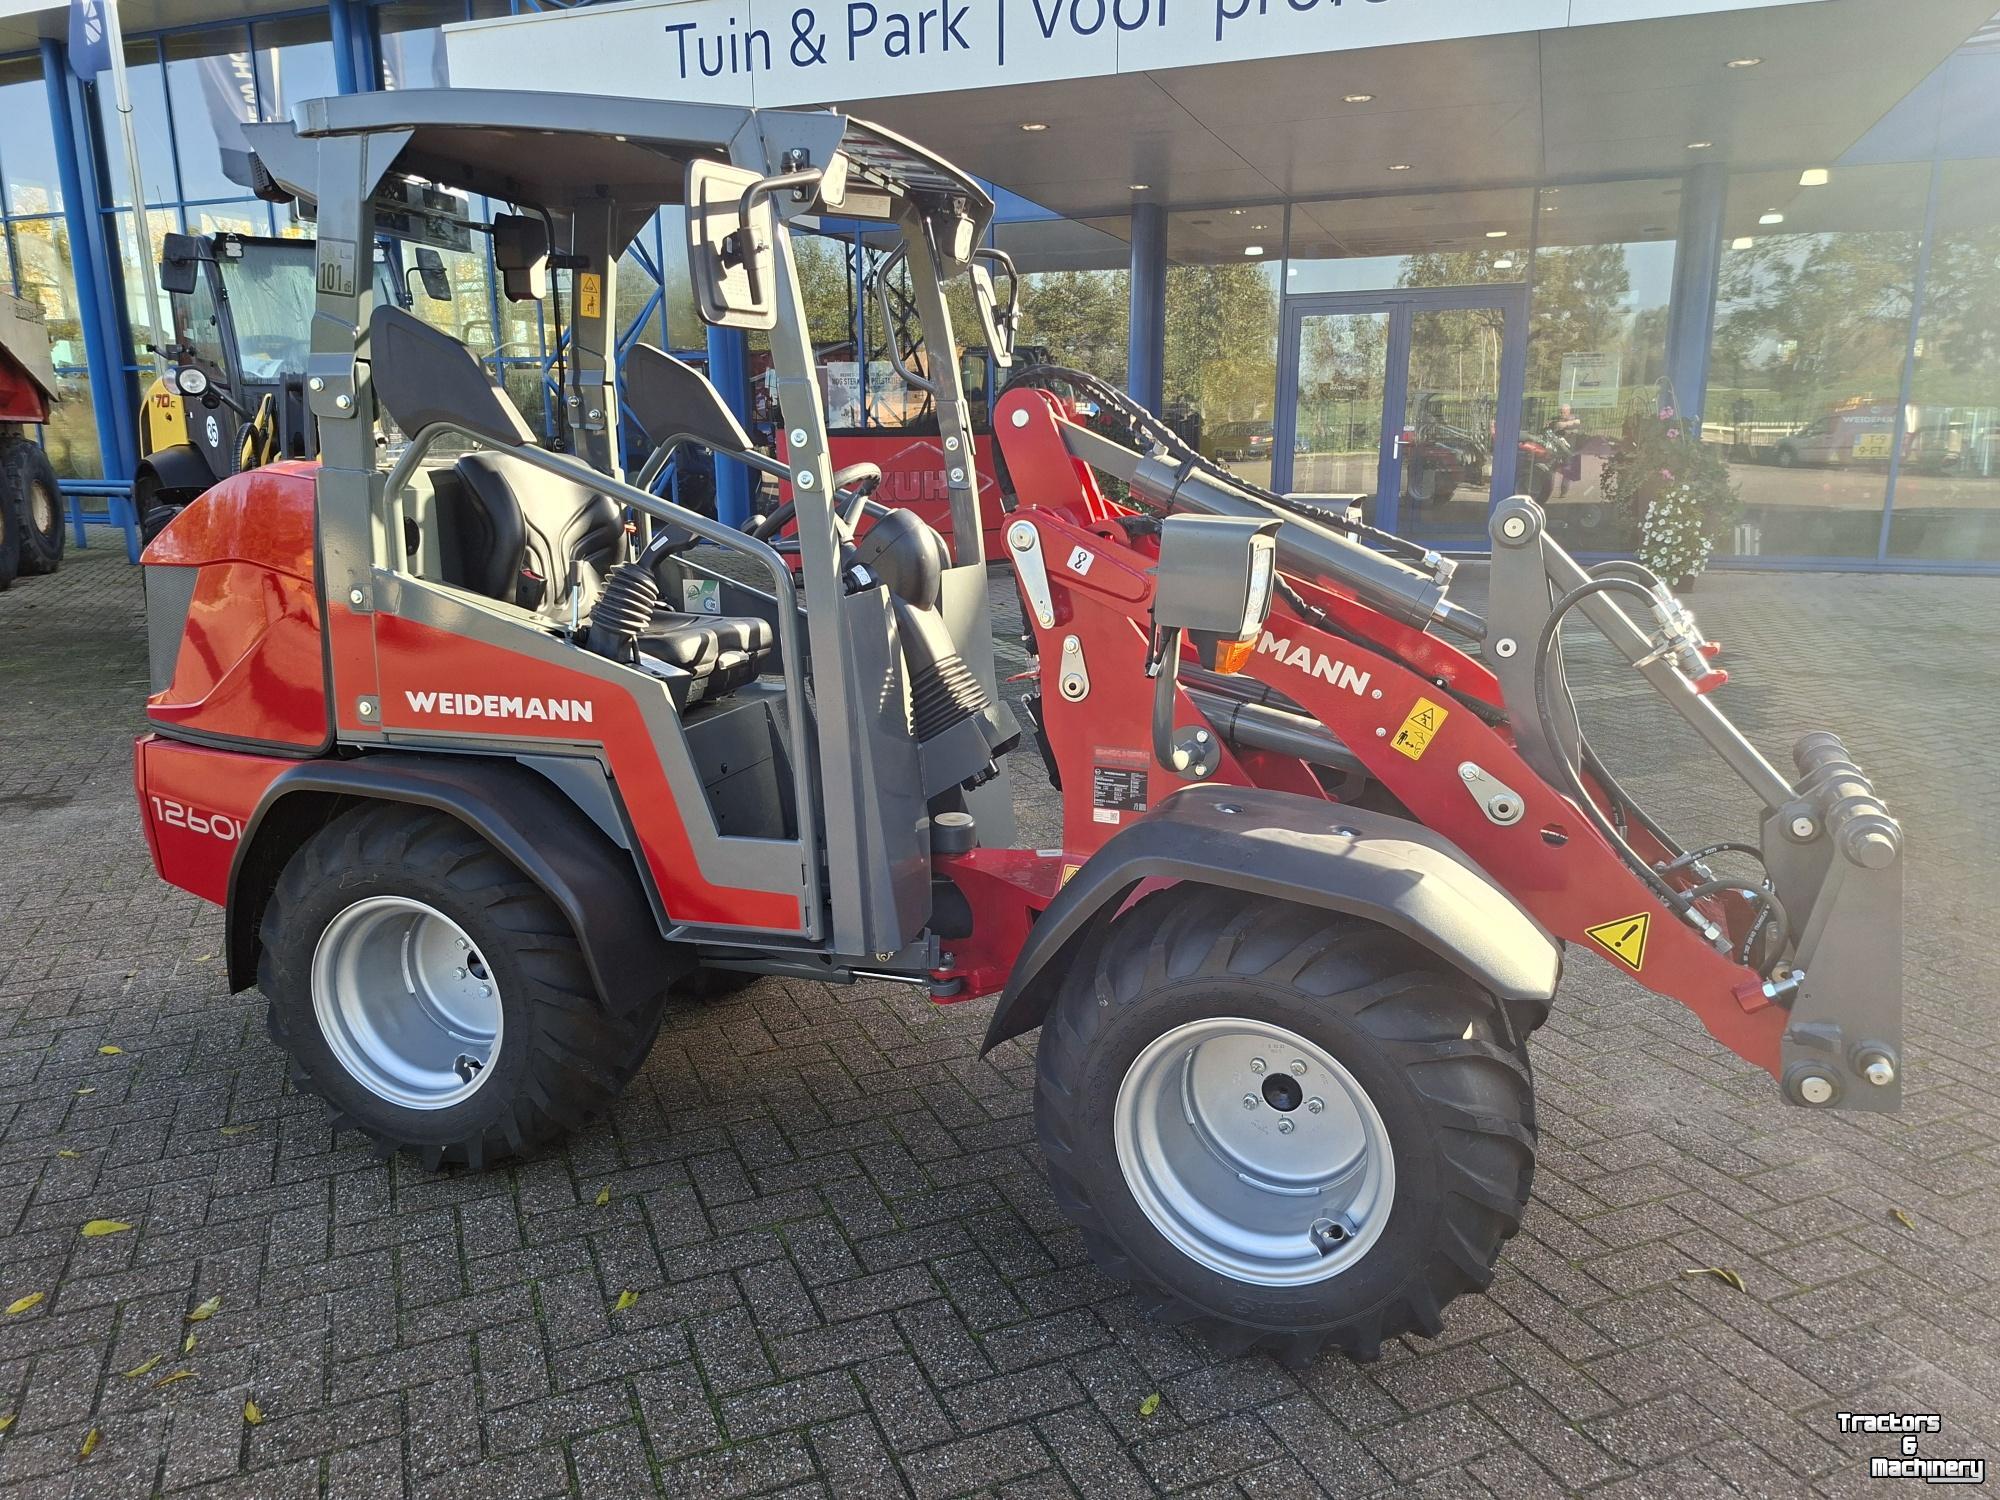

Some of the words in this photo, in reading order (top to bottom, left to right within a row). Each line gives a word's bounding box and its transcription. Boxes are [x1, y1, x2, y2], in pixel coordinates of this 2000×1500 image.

[665, 17, 771, 79] Tuin
[790, 8, 827, 67] &
[847, 0, 970, 61] Park
[320, 263, 342, 291] 101
[871, 471, 949, 502] KUH
[1257, 629, 1371, 696] MANN
[405, 690, 593, 722] WEIDEMANN
